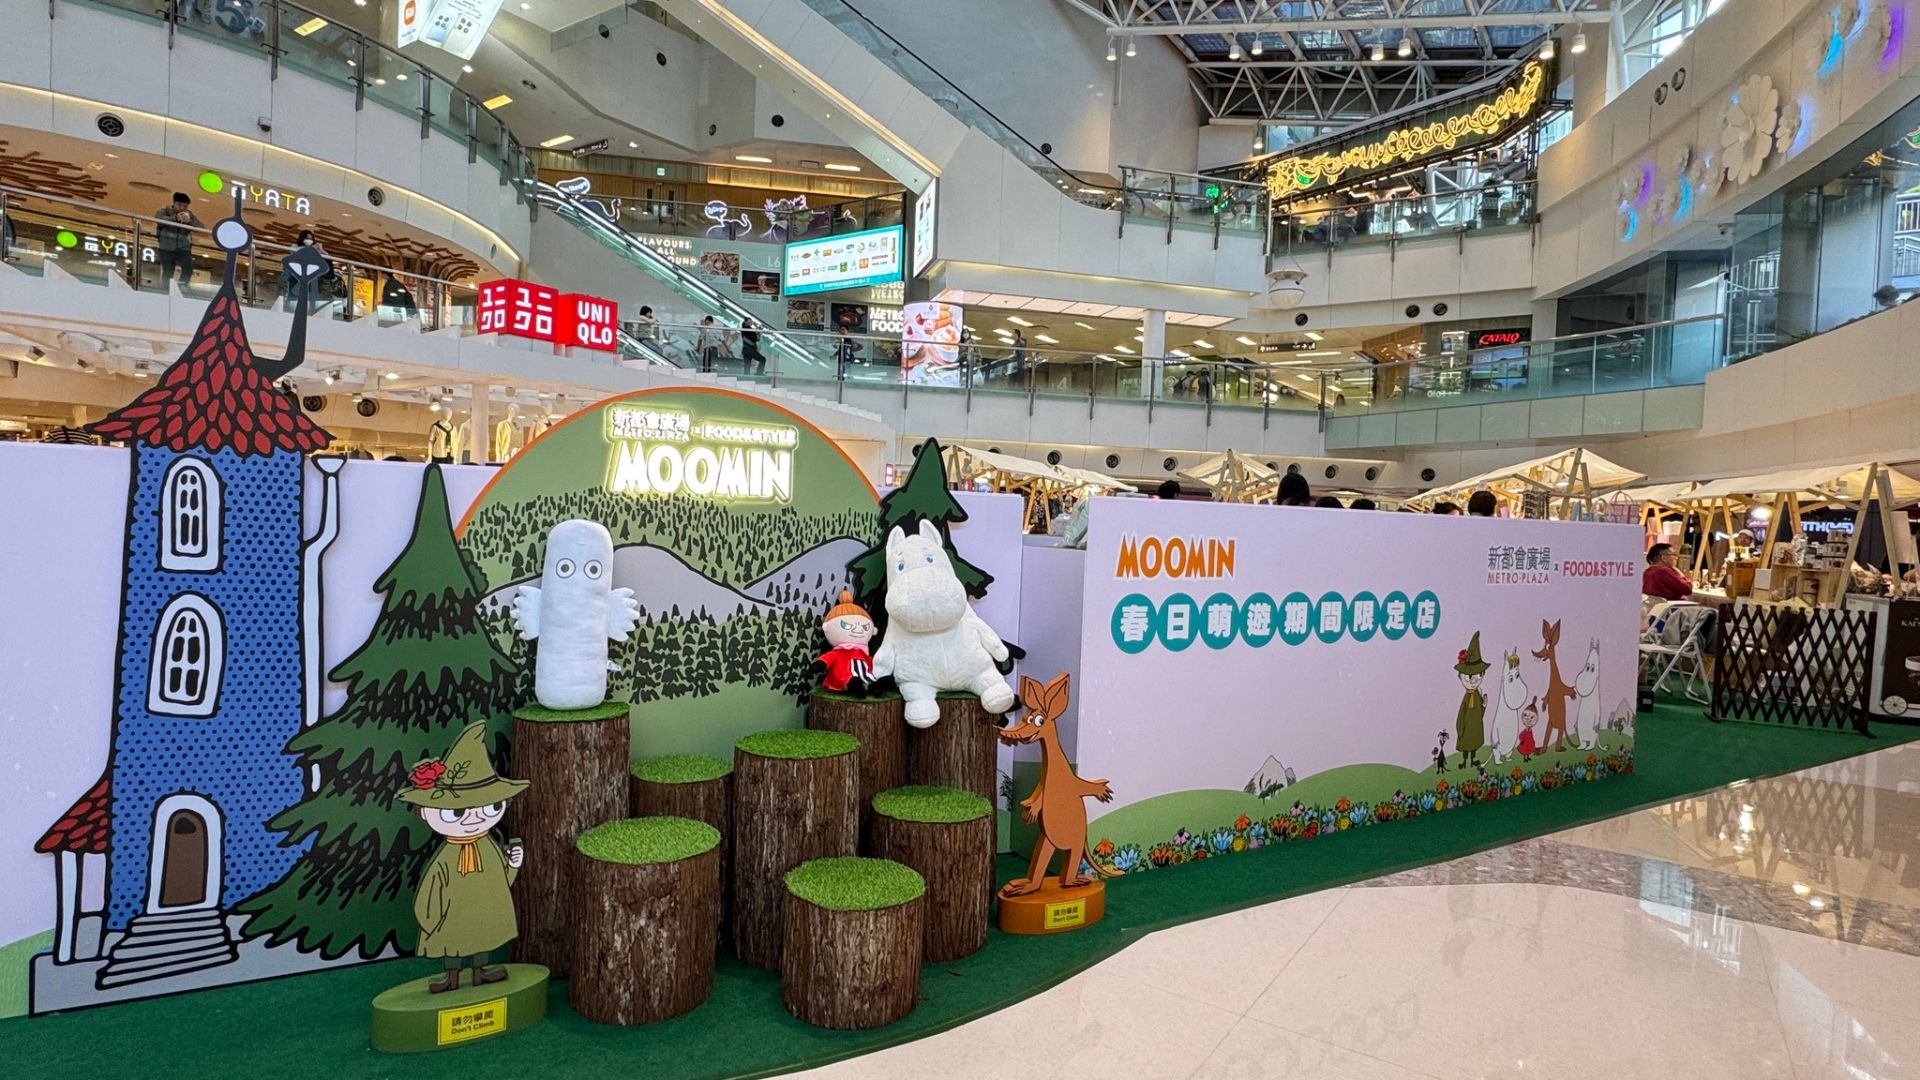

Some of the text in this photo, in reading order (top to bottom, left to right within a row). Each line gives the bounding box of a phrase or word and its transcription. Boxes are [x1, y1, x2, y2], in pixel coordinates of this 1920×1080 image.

[250, 185, 310, 216] YATA
[101, 239, 155, 263] YAA
[767, 255, 781, 268] L6
[578, 300, 610, 324] UNI
[577, 322, 612, 345] QLO
[612, 440, 791, 499] MOOMIN
[1115, 533, 1236, 579] MOOMIN
[1488, 545, 1551, 571] 新都會廣場
[1563, 560, 1634, 577] FOOD&STYLE
[451, 1020, 495, 1035] Don't Climb
